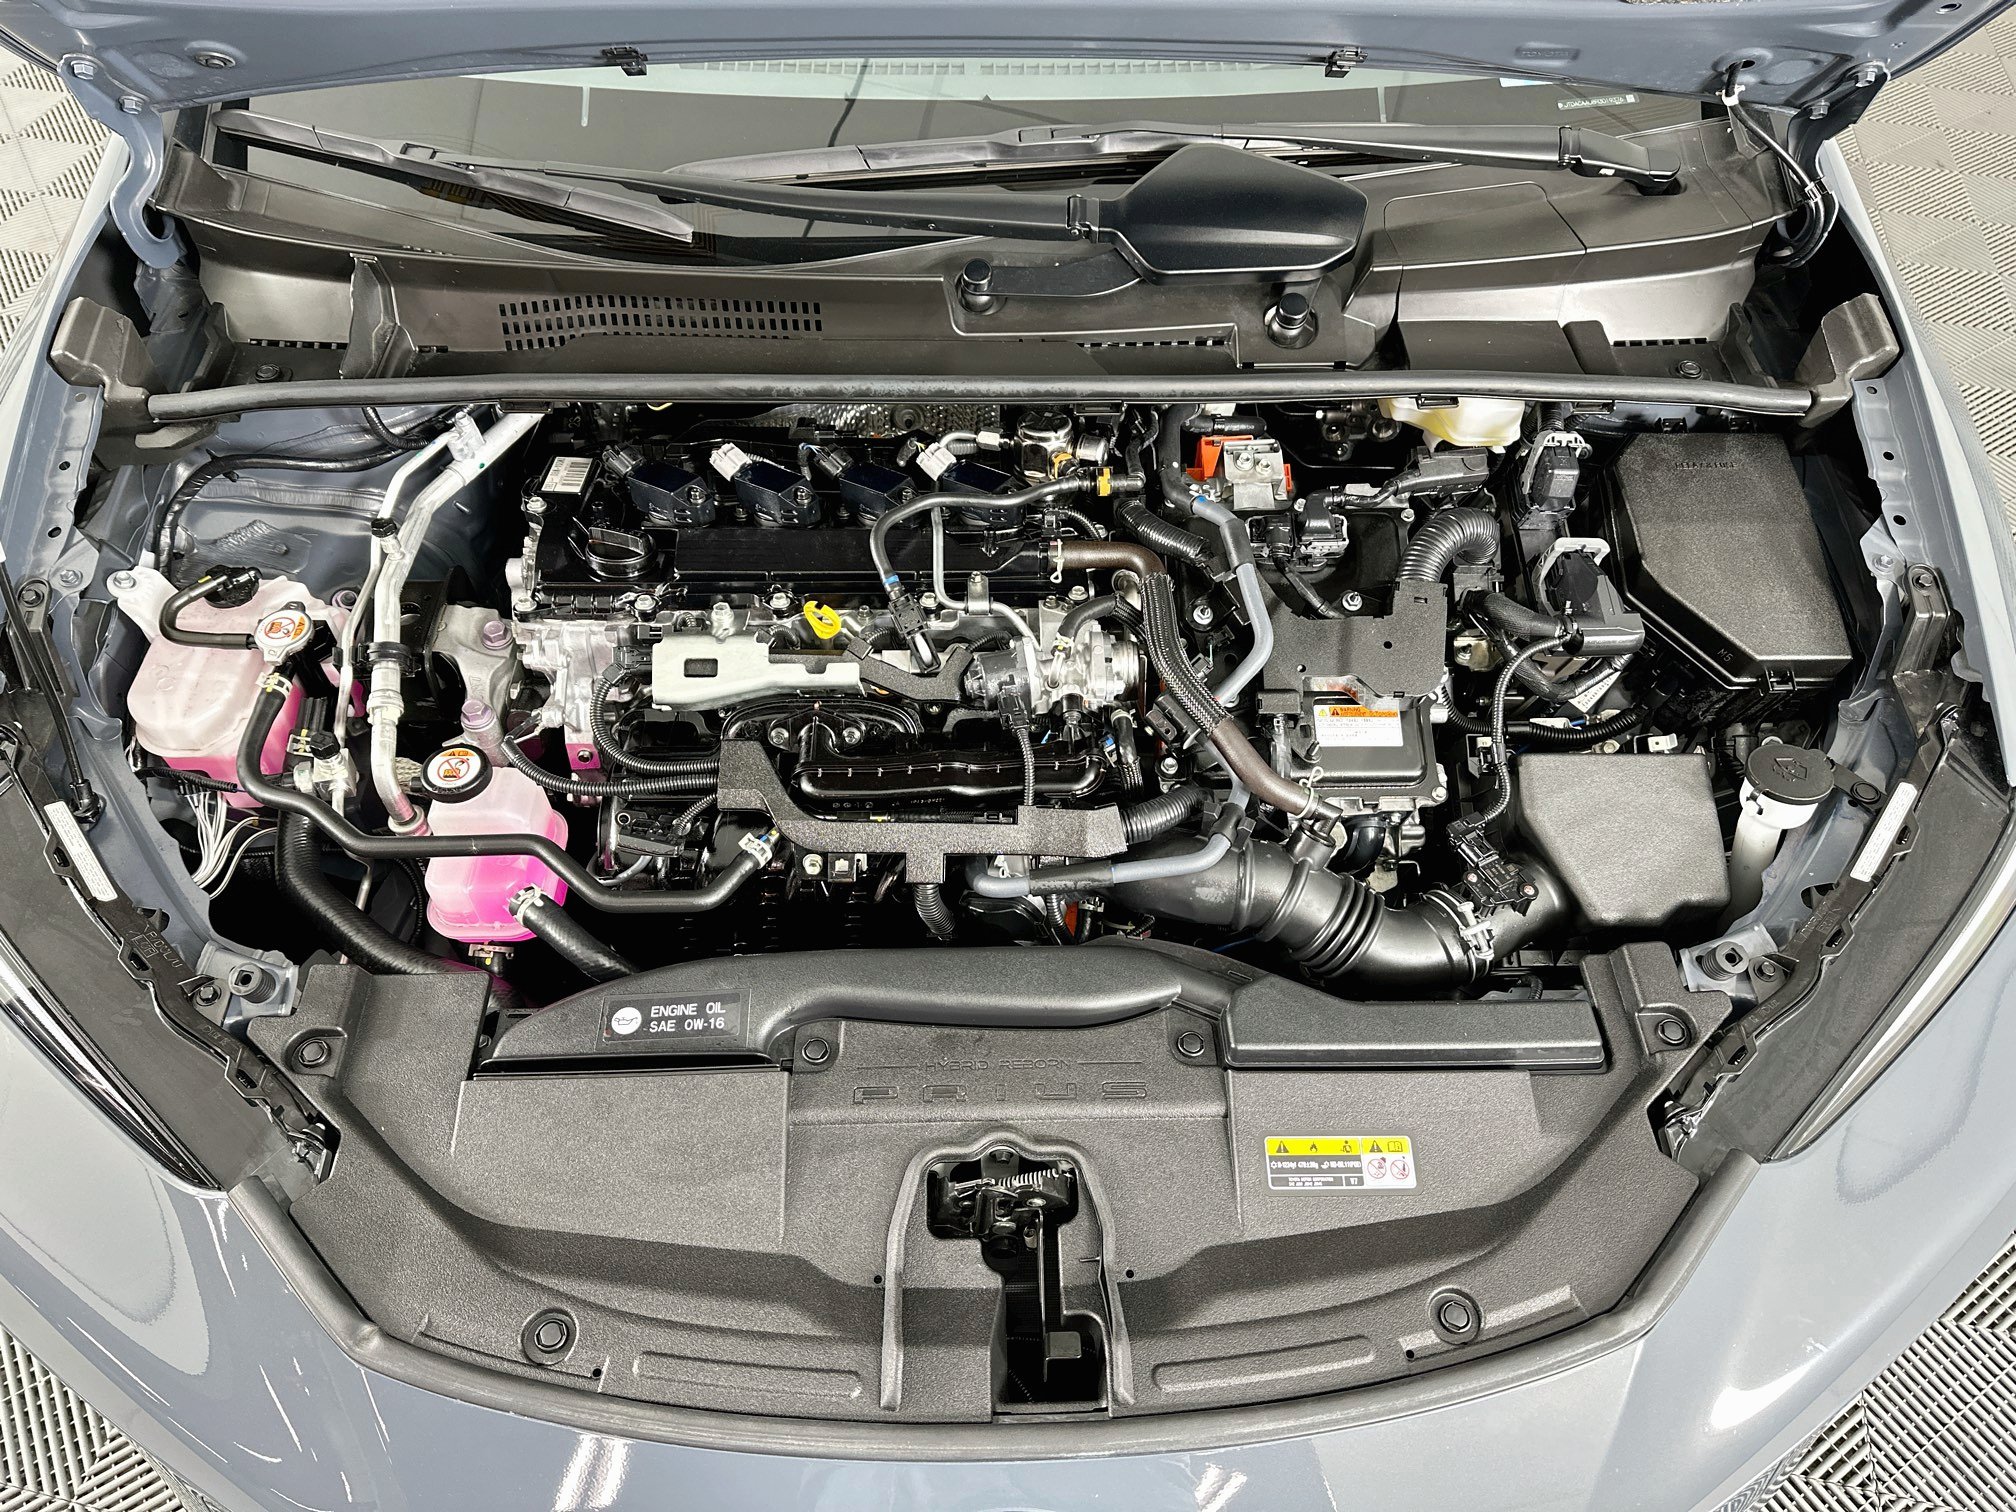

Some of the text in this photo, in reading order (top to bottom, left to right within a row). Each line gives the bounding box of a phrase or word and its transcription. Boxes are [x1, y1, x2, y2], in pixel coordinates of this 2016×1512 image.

[651, 1001, 726, 1017] ENGINE OIL
[649, 1017, 725, 1033] SAE 0W-16
[925, 1058, 1070, 1072] HYBRID REBORN
[852, 1081, 1147, 1104] PRIUS
